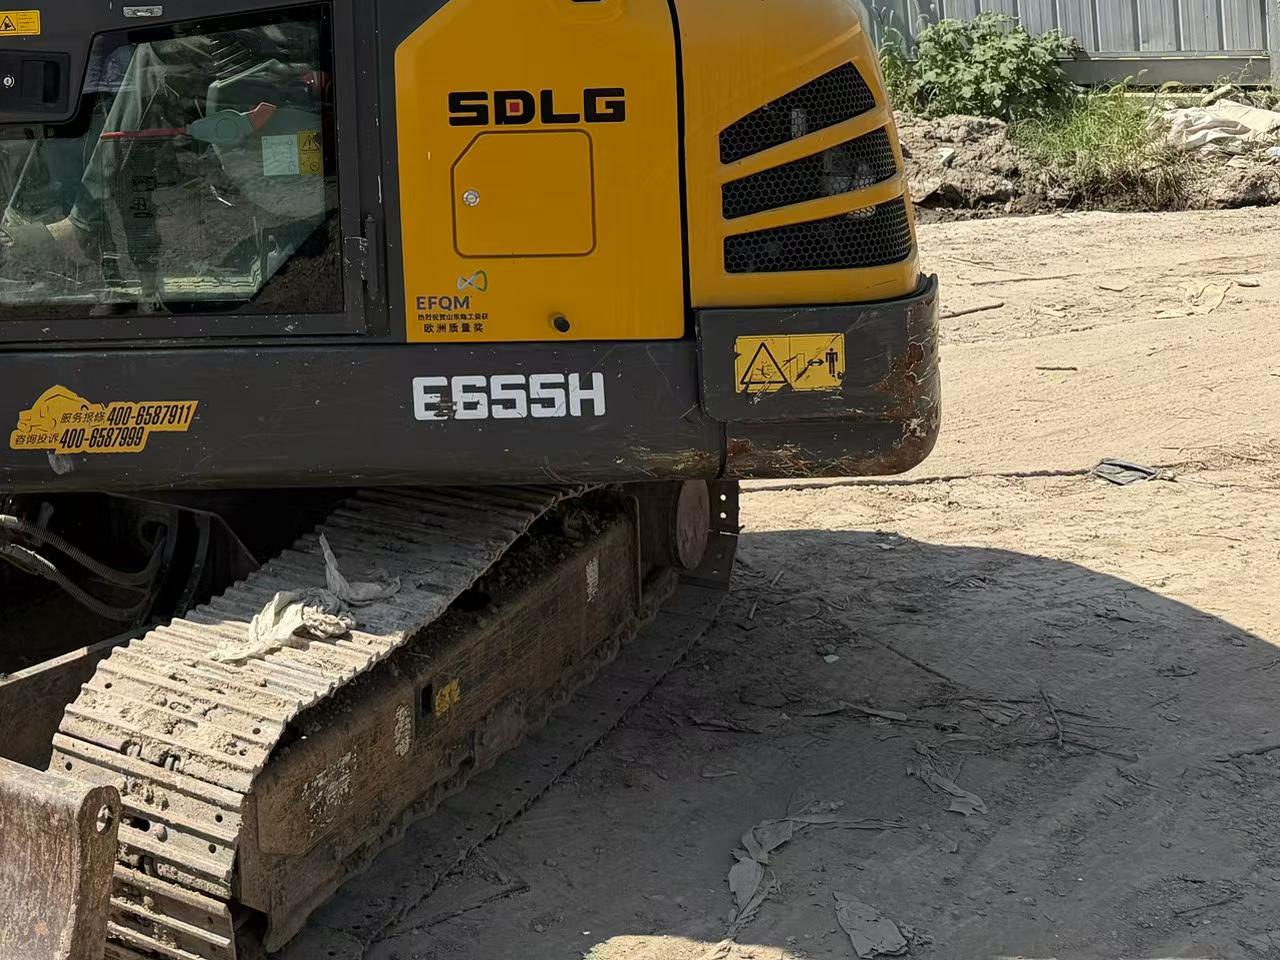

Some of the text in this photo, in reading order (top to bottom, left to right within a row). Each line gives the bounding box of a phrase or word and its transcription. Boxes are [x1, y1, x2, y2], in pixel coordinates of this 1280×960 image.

[448, 87, 626, 126] SDLG
[416, 296, 470, 311] EFQM
[423, 323, 484, 334] 欧洲质量奖
[413, 372, 606, 421] E655H
[107, 404, 192, 426] 400-6587911
[59, 426, 145, 449] 400-6587999
